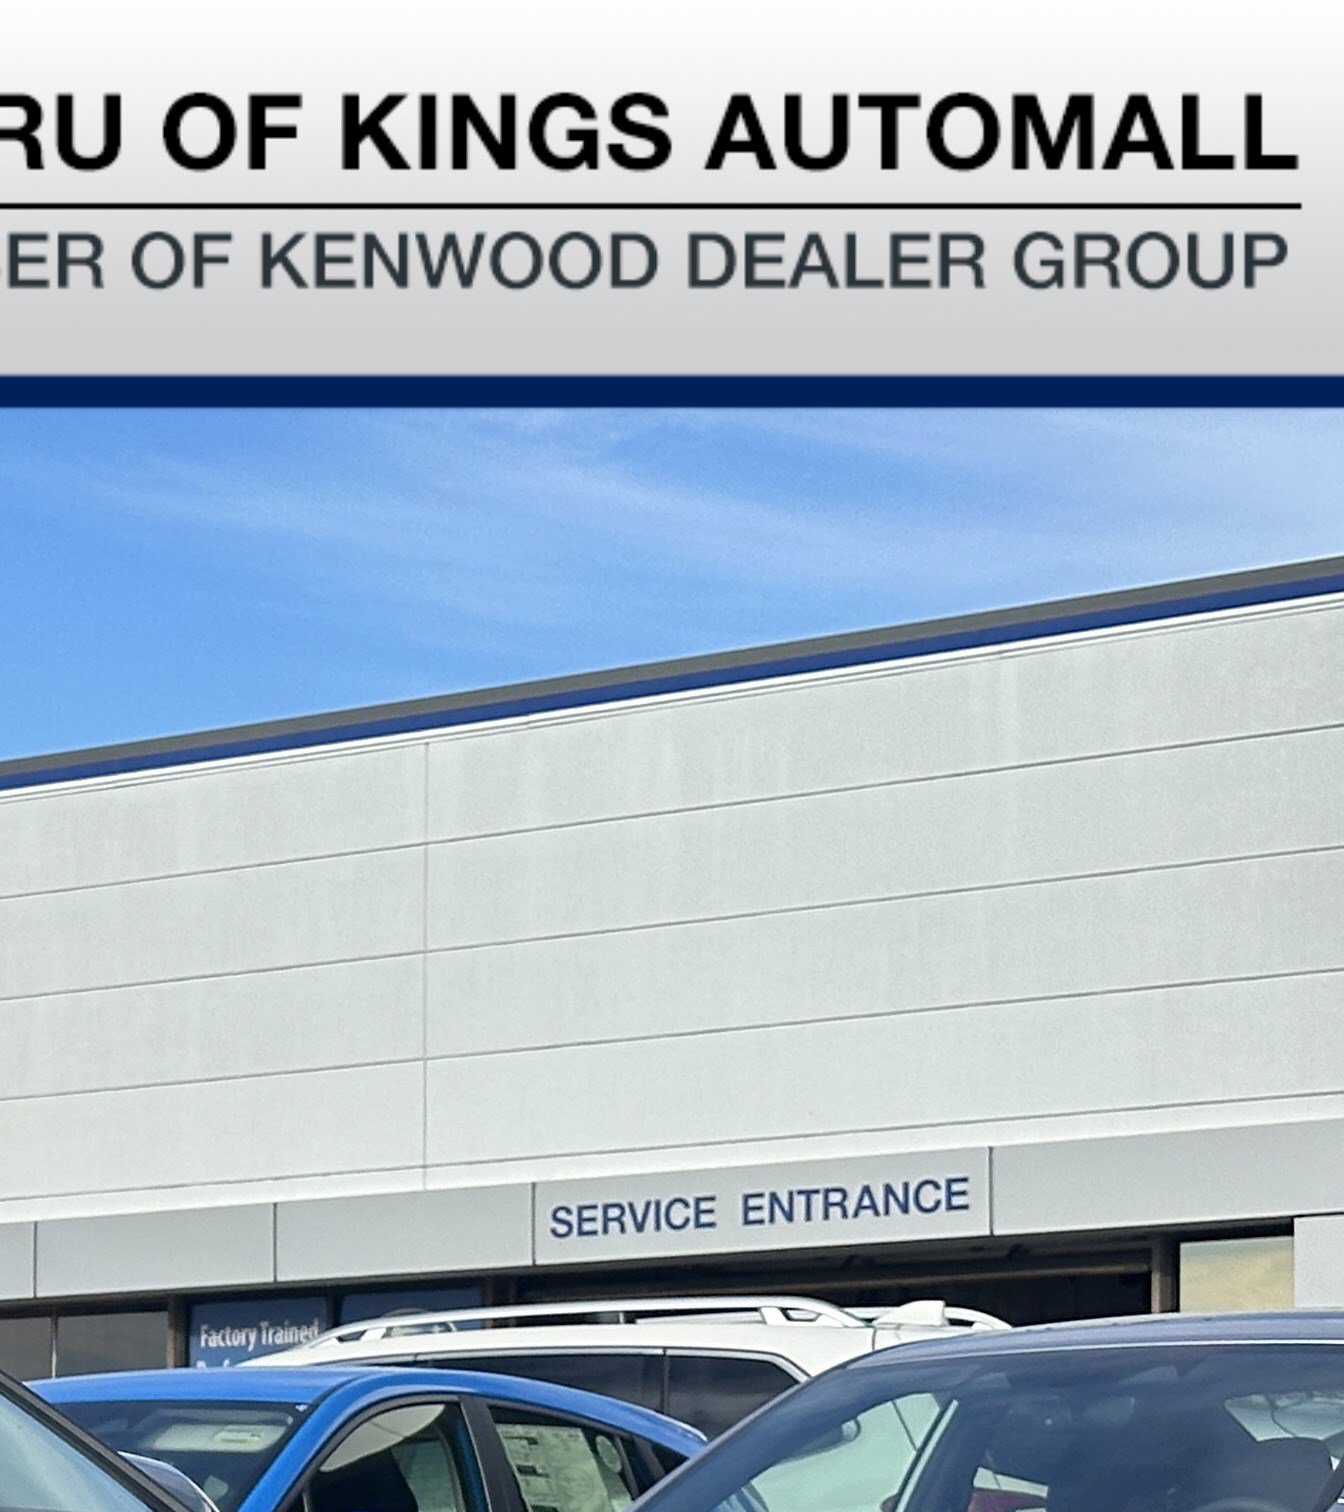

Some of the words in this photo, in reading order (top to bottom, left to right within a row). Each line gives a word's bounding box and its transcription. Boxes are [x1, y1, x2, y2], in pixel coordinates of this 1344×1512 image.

[549, 1196, 717, 1239] SERVICE
[742, 1176, 970, 1226] ENTRANCE
[200, 1323, 258, 1351] Factory
[260, 1318, 320, 1346] Trained
